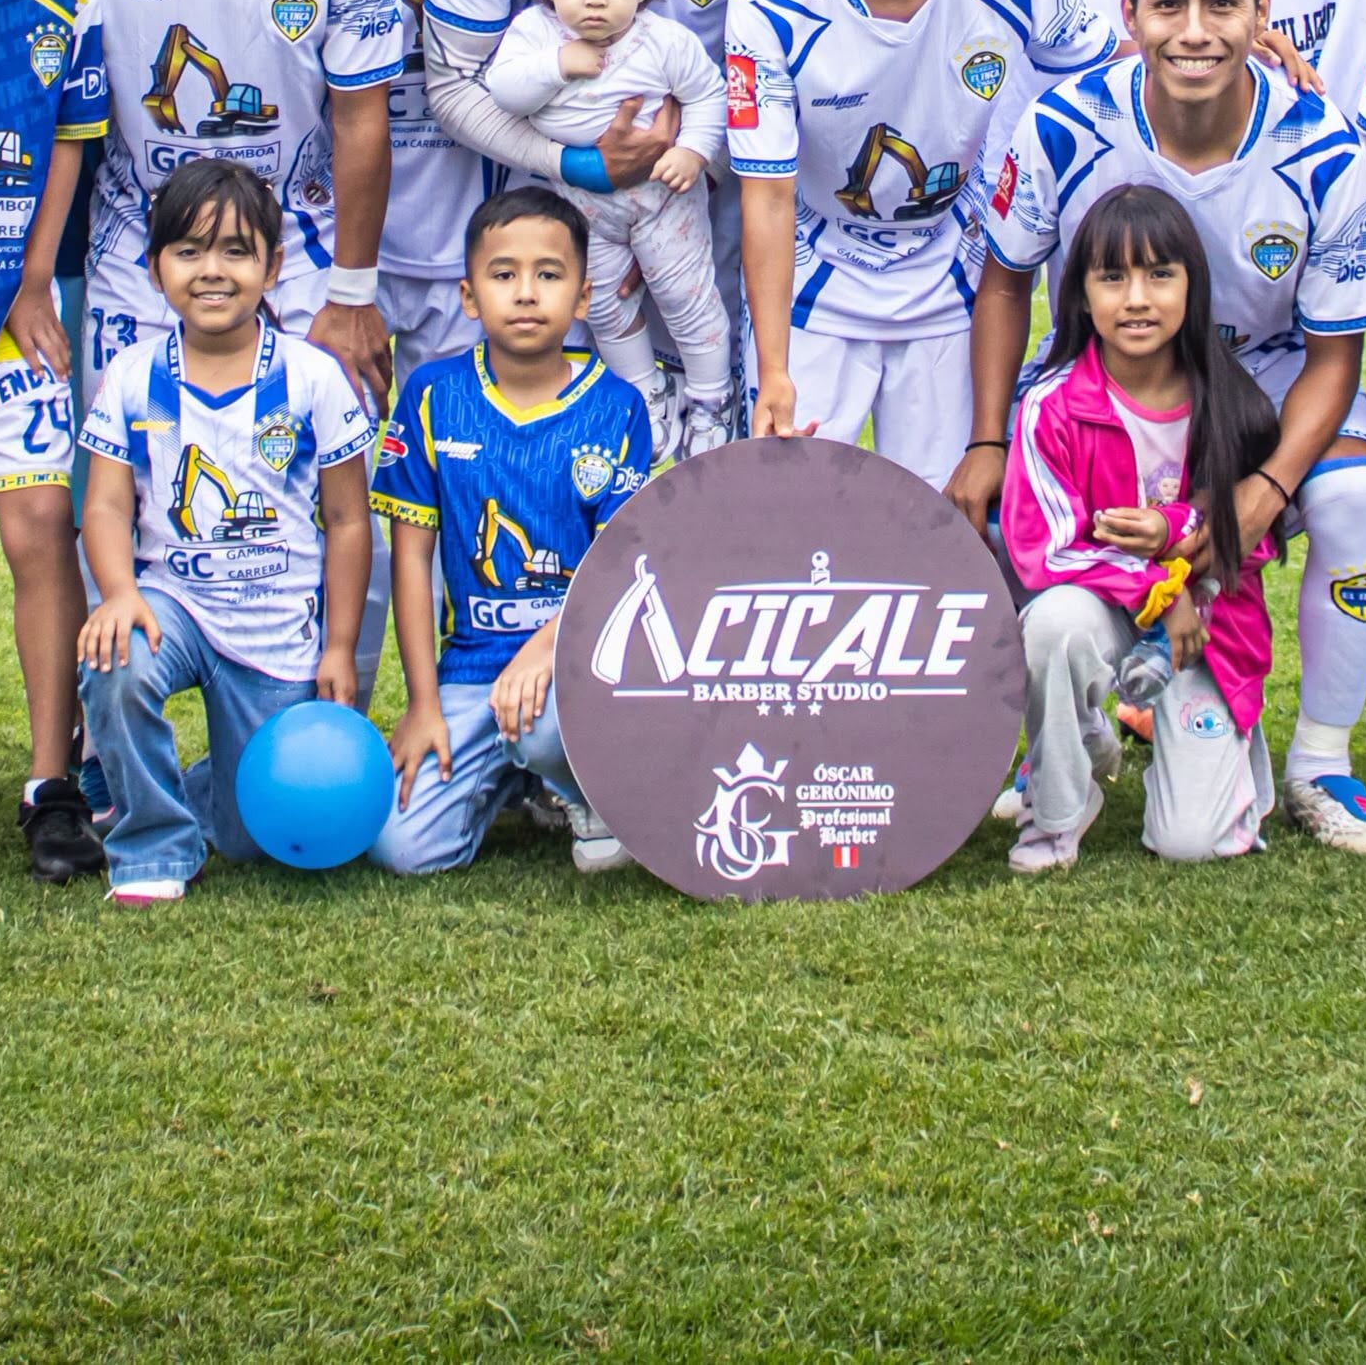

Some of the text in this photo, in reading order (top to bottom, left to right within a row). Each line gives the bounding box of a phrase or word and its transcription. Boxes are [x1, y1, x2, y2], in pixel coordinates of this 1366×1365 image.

[360, 9, 403, 42] DieA
[387, 88, 407, 118] C
[214, 146, 276, 159] GAMBOA
[410, 138, 456, 149] CARRERA
[842, 223, 897, 249] GC
[91, 307, 138, 371] 13
[226, 544, 285, 560] GAMBOA
[167, 549, 214, 578] GC
[228, 562, 283, 579] CARRERA
[531, 598, 567, 609] GAM
[1341, 591, 1354, 600] EL
[473, 600, 520, 629] GC
[692, 682, 887, 702] BARBER STUDIO
[813, 763, 874, 782] ÓSCAR
[795, 782, 895, 802] GERÓNIMO
[799, 808, 892, 829] Profesional
[819, 826, 877, 848] Barber
